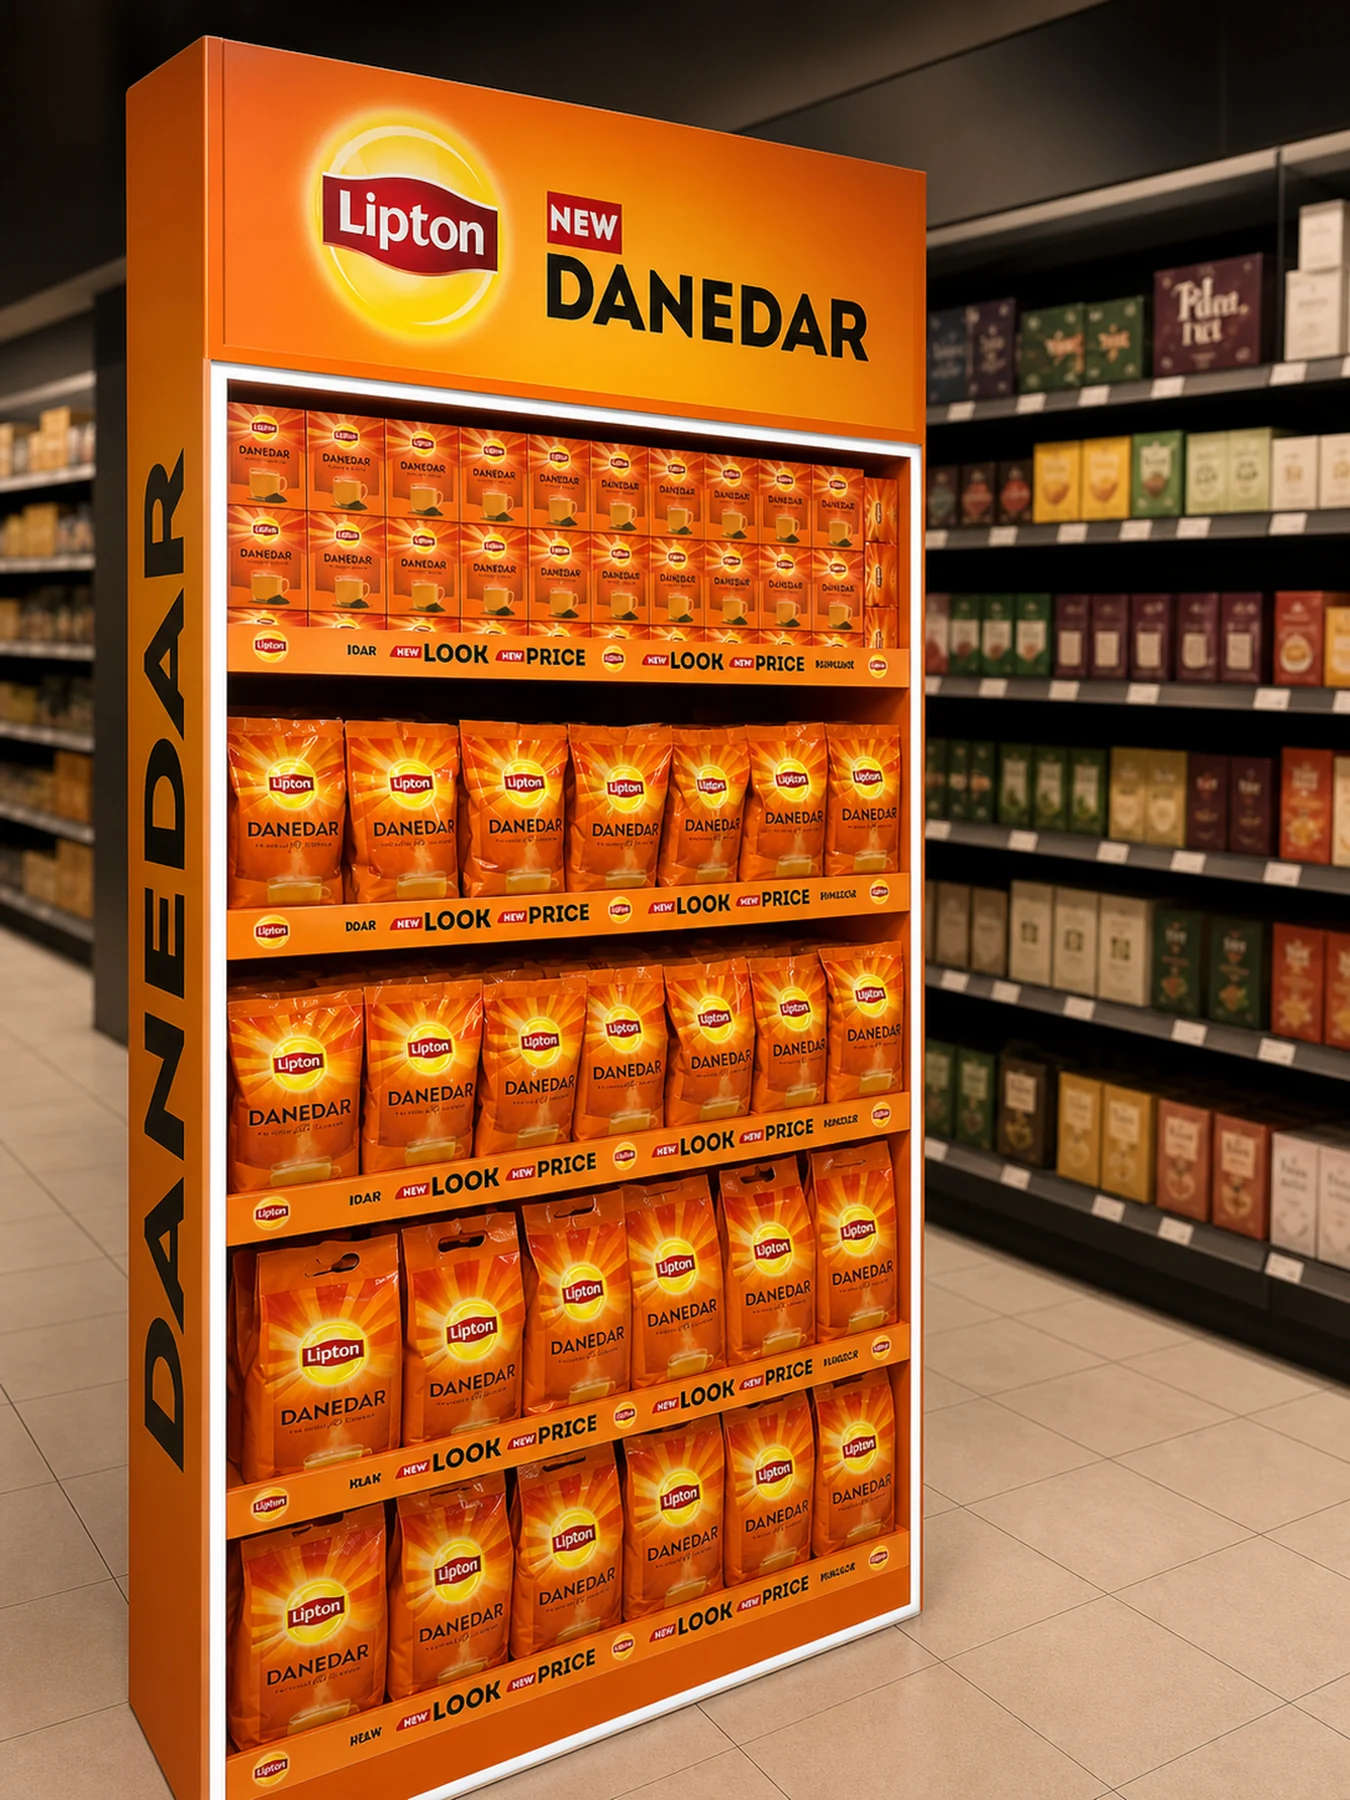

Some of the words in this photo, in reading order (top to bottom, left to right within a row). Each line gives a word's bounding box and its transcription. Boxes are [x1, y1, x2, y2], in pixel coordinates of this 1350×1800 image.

[338, 189, 485, 257] Lipton
[550, 205, 619, 242] NEW
[546, 252, 869, 363] DANEDAR
[239, 445, 290, 459] DANEDAR
[424, 643, 489, 663] LOOK
[527, 647, 585, 666] PRICE
[670, 651, 724, 671] LOOK
[756, 655, 804, 672] PRICE
[272, 778, 311, 791] Lipton
[393, 777, 431, 791] Lipton
[506, 777, 543, 789] Lipton
[609, 781, 642, 796] Lipton
[685, 818, 740, 831] DANEDAR
[765, 810, 823, 824] DANEDAR
[842, 807, 896, 821] DANEDAR
[248, 821, 339, 838] DANEDAR
[374, 819, 454, 837] DANEDAR
[489, 818, 562, 834] DANEDAR
[592, 823, 658, 837] DANEDAR
[677, 894, 731, 915] LOOK
[762, 889, 810, 907] PRICE
[397, 919, 420, 929] NEW
[425, 909, 491, 931] LOOK
[529, 904, 589, 924] PRICE
[143, 448, 186, 1474] DANEDAR
[524, 1035, 557, 1048] Lipton
[848, 1023, 901, 1042] DANEDAR
[410, 1041, 449, 1056] Lipton
[773, 1039, 826, 1057] DANEDAR
[277, 1055, 320, 1072] Lipton
[593, 1060, 662, 1081] DANEDAR
[691, 1049, 752, 1070] DANEDAR
[388, 1083, 473, 1106] DANEDAR
[505, 1075, 574, 1095] DANEDAR
[249, 1099, 351, 1126] DANEDAR
[680, 1131, 734, 1155] LOOK
[765, 1119, 814, 1141] PRICE
[403, 1185, 427, 1197] NEW
[432, 1167, 499, 1196] LOOK
[538, 1152, 596, 1178] PRICE
[757, 1240, 790, 1259] Lipton
[659, 1258, 693, 1276] Lipton
[832, 1260, 894, 1286] DANEDAR
[565, 1284, 601, 1301] Lipton
[745, 1280, 811, 1306] DANEDAR
[648, 1298, 717, 1328] DANEDAR
[450, 1318, 494, 1339] Lipton
[552, 1326, 625, 1355] DANEDAR
[306, 1343, 361, 1364] Lipton
[430, 1364, 515, 1397] DANEDAR
[680, 1379, 735, 1408] LOOK
[765, 1359, 813, 1386] PRICE
[281, 1390, 386, 1426] DANEDAR
[403, 1462, 428, 1476] NEW
[433, 1437, 501, 1472] LOOK
[539, 1414, 597, 1444] PRICE
[758, 1464, 791, 1482] Lipton
[663, 1487, 698, 1508] Lipton
[832, 1474, 892, 1504] DANEDAR
[745, 1500, 809, 1532] DANEDAR
[555, 1528, 593, 1549] Lipton
[648, 1526, 719, 1561] DANEDAR
[438, 1559, 478, 1583] Lipton
[539, 1567, 615, 1605] DANEDAR
[291, 1600, 341, 1624] Lipton
[678, 1601, 733, 1635] LOOK
[762, 1576, 809, 1605] PRICE
[419, 1603, 503, 1642] DANEDAR
[266, 1644, 369, 1686] DANEDAR
[403, 1712, 428, 1727] NEW
[433, 1680, 500, 1721] LOOK
[538, 1649, 595, 1683] PRICE
